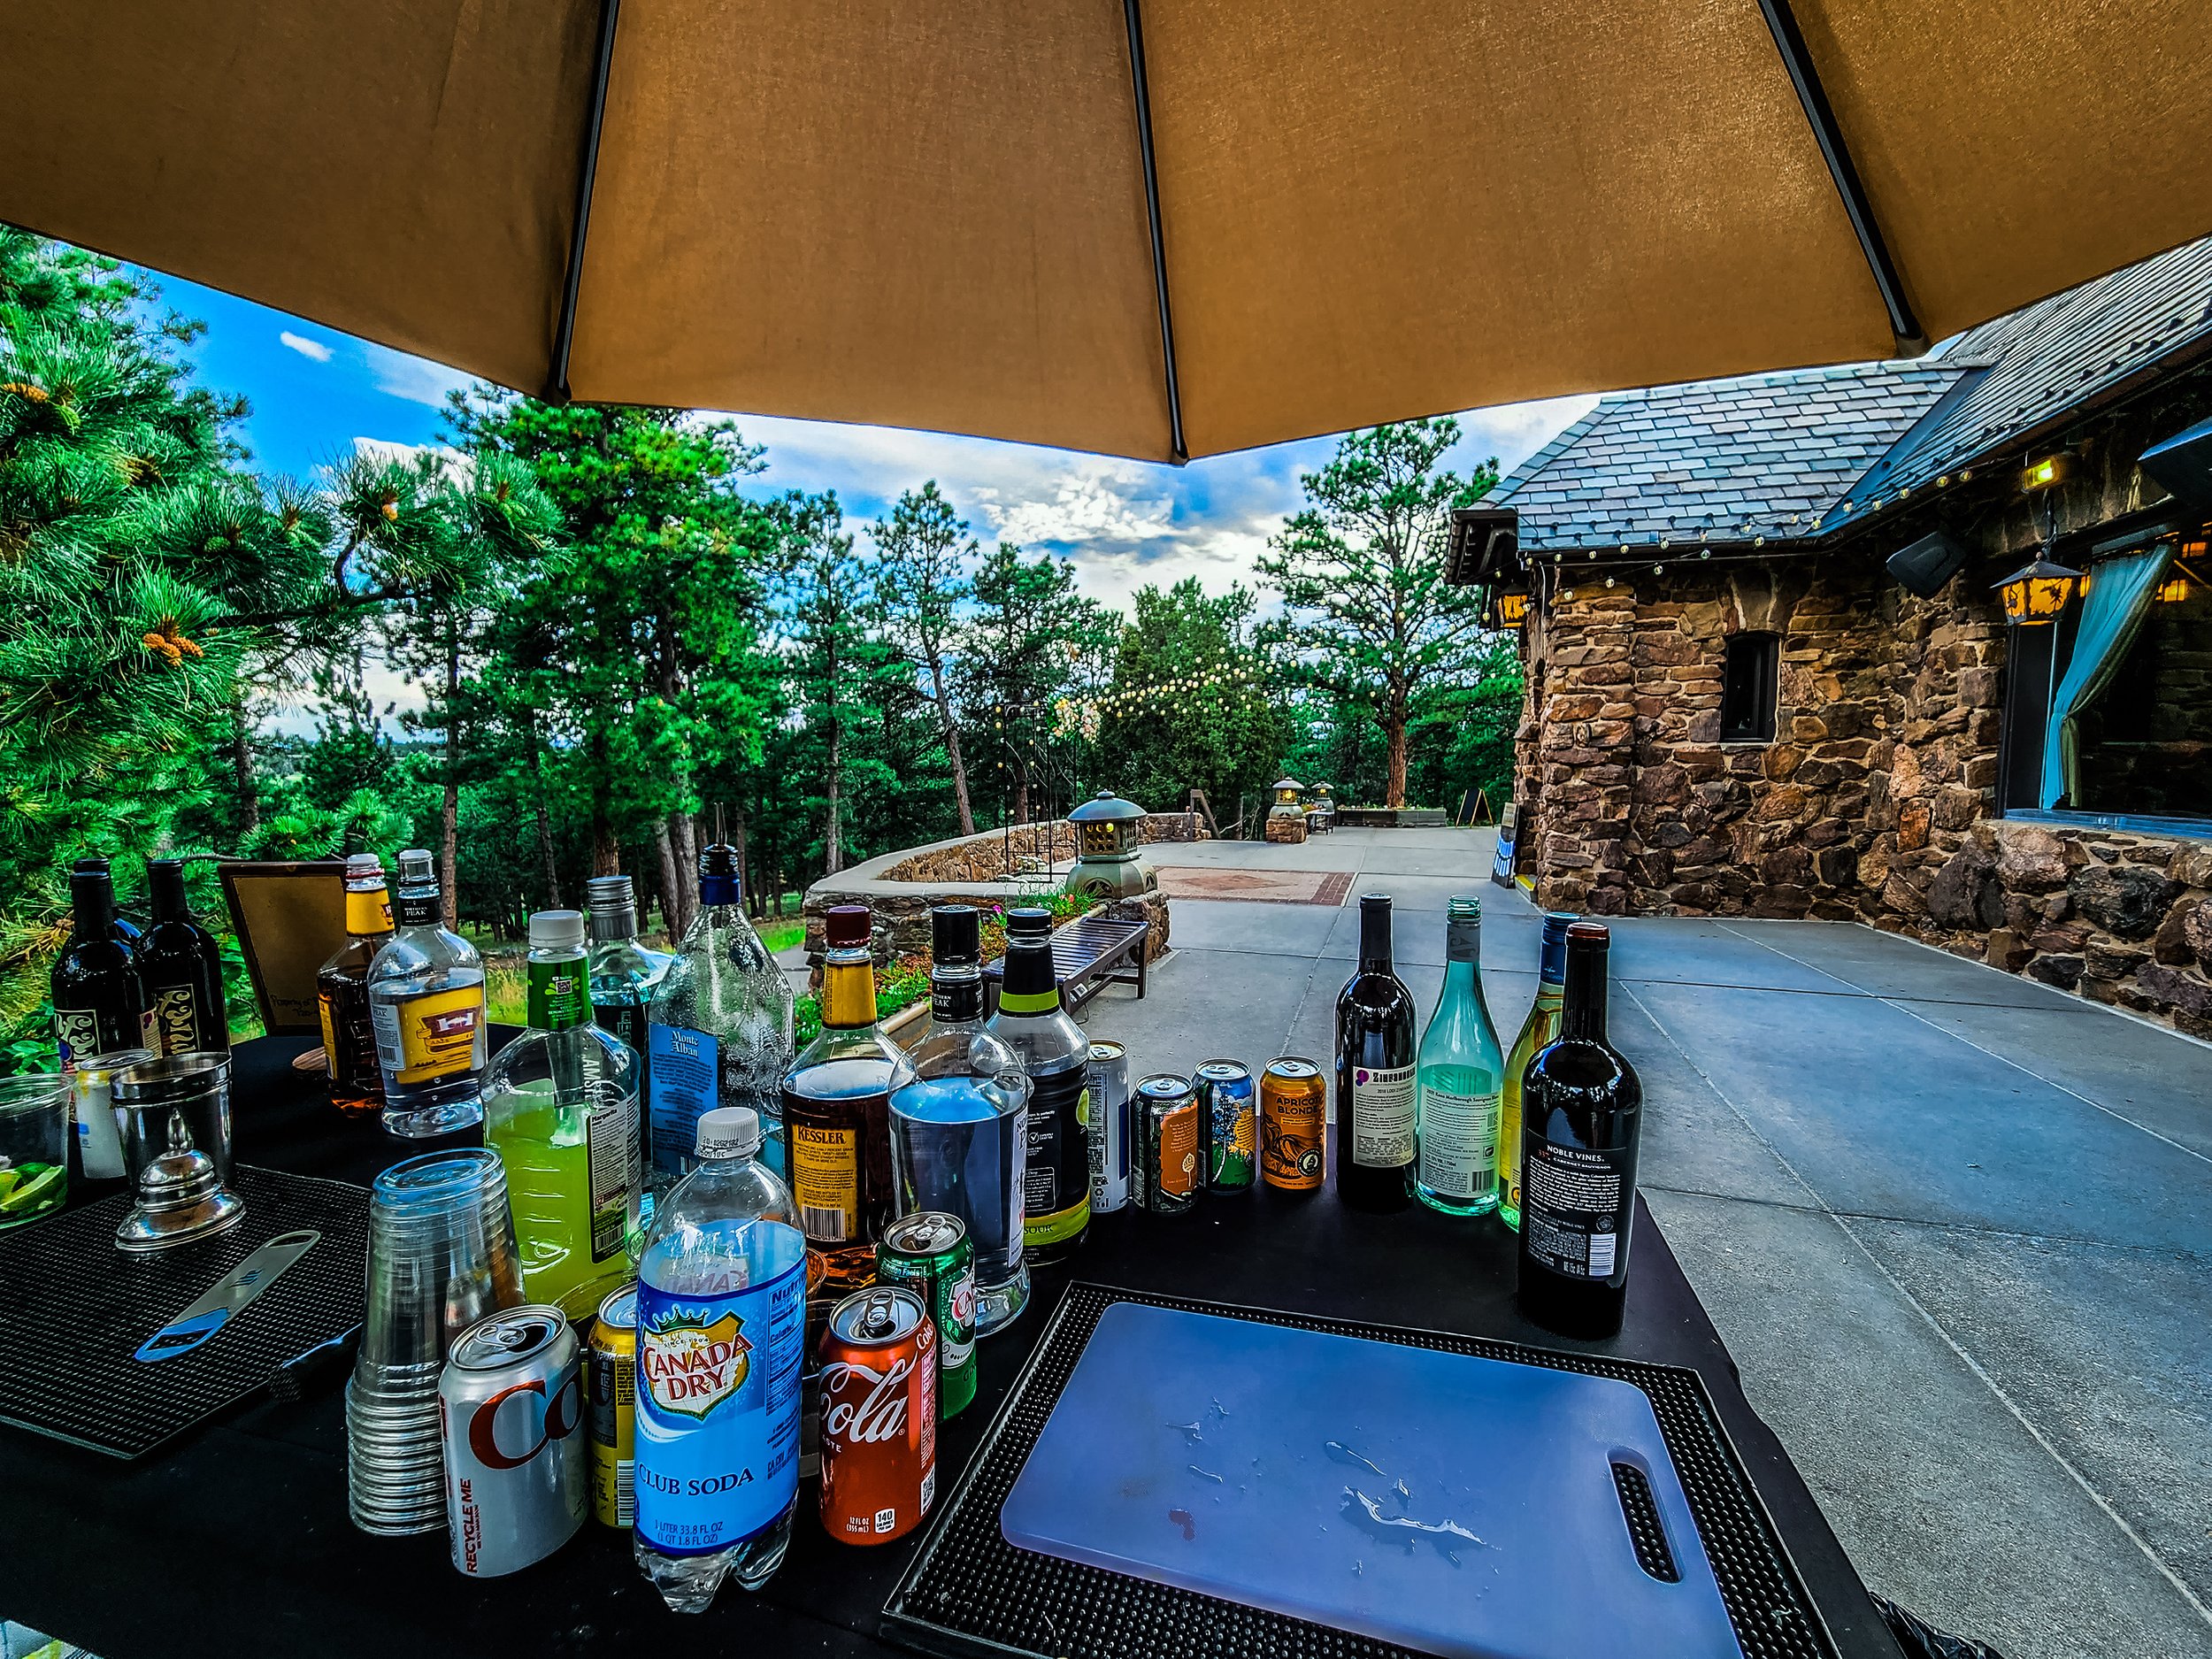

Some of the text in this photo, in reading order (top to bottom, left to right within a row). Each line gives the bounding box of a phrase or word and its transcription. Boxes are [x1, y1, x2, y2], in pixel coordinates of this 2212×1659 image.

[671, 1031, 699, 1046] Monte
[671, 1041, 699, 1058] Alban
[1276, 1097, 1319, 1106] APRICOT
[591, 1109, 618, 1122] Margarita
[1278, 1106, 1318, 1115] BLONDE
[798, 1125, 846, 1144] KESSLER
[1547, 1145, 1573, 1159] NOBLE
[1554, 1157, 1580, 1167] CABERNET
[1023, 1225, 1053, 1235] SOUR
[664, 1340, 684, 1348] SINCE
[917, 1324, 934, 1350] Coke
[642, 1333, 755, 1383] CANADA
[666, 1364, 726, 1401] DRY
[639, 1463, 755, 1497] CLUB SODA
[459, 1478, 472, 1503] ME
[862, 1517, 869, 1525] OZ
[877, 1510, 892, 1522] 140
[658, 1520, 678, 1532] LITER
[680, 1524, 697, 1535] 33.8
[699, 1522, 710, 1533] FL
[711, 1521, 724, 1532] OZ
[462, 1504, 478, 1574] RECYCLE
[665, 1534, 675, 1544] QT
[678, 1536, 690, 1546] 1.8
[692, 1535, 701, 1545] FL
[703, 1534, 718, 1544] OZ)
